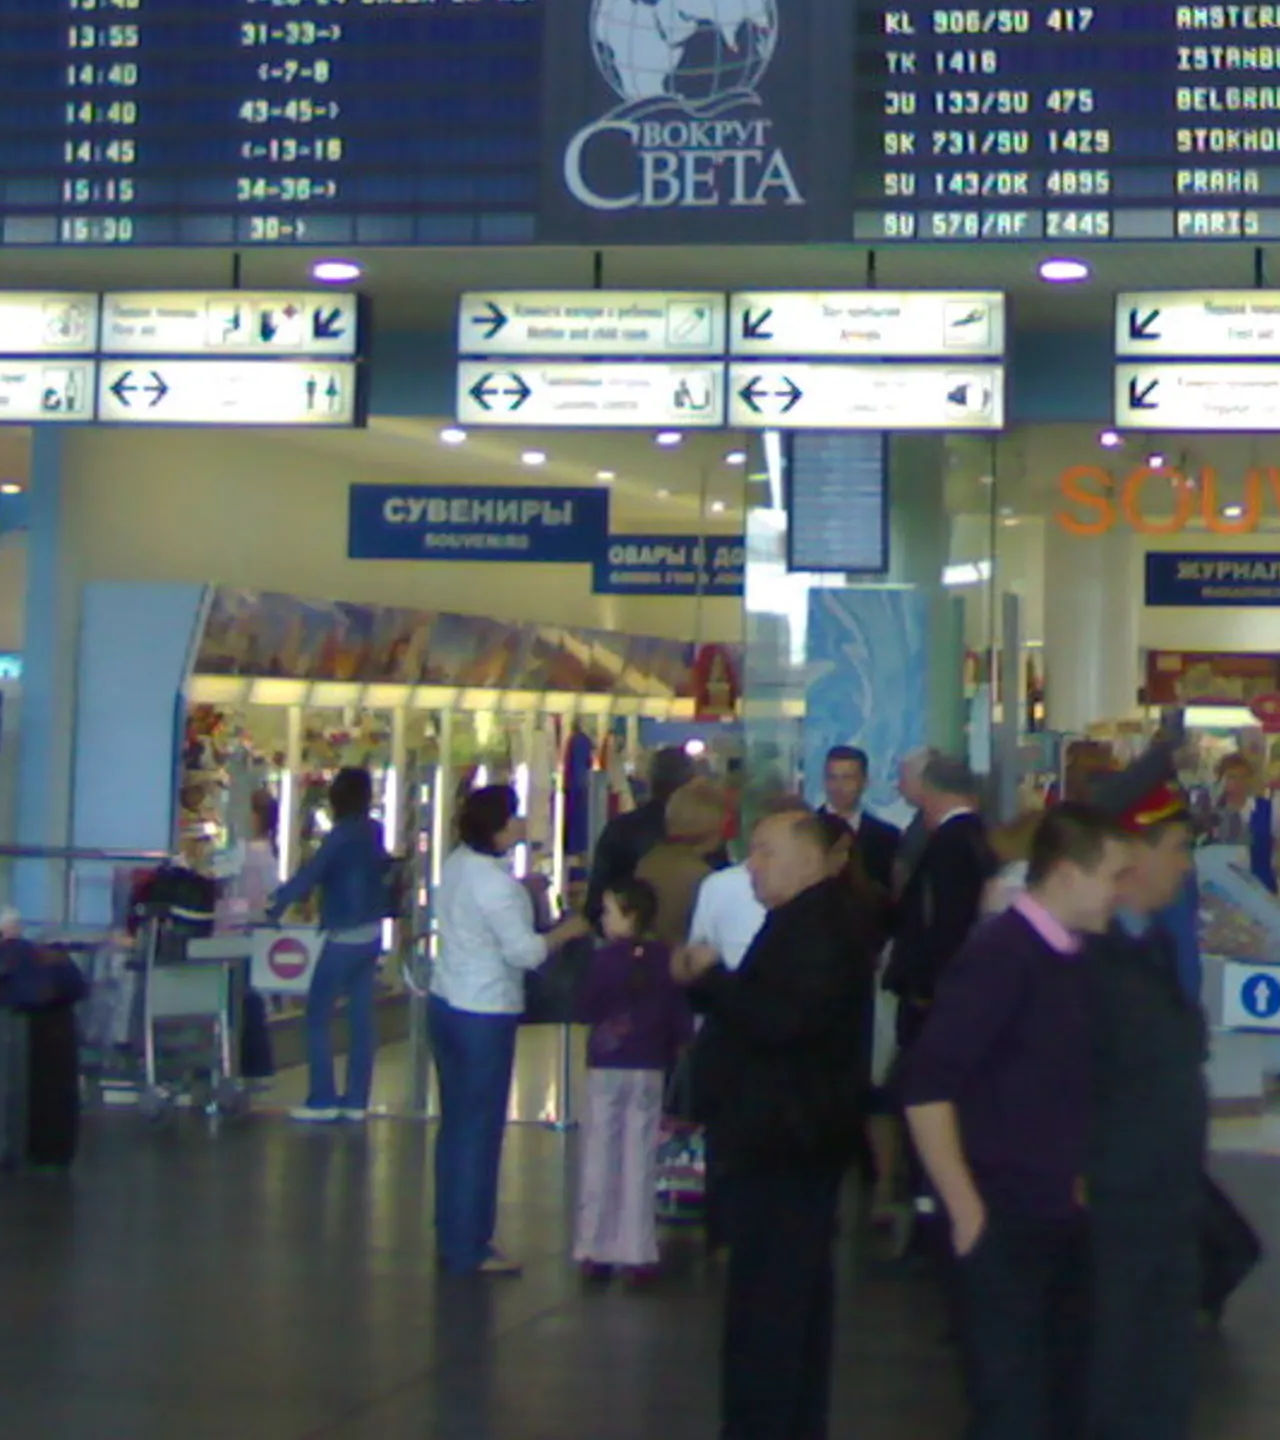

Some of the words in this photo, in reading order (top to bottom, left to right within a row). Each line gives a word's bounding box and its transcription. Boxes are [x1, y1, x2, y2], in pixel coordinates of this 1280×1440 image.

[885, 10, 915, 35] KL
[1046, 7, 1094, 32] 417
[885, 50, 916, 74] TK
[1046, 87, 1094, 113] 475
[642, 119, 772, 149] ВОКРУГ
[1048, 128, 1111, 154] 1429
[563, 120, 805, 210] СВЕТА
[62, 178, 134, 203] 15:15
[884, 171, 916, 196] SU
[1176, 168, 1259, 194] PRAHA
[1177, 209, 1259, 235] PARIS
[383, 497, 574, 526] СУВЕНИРЫ
